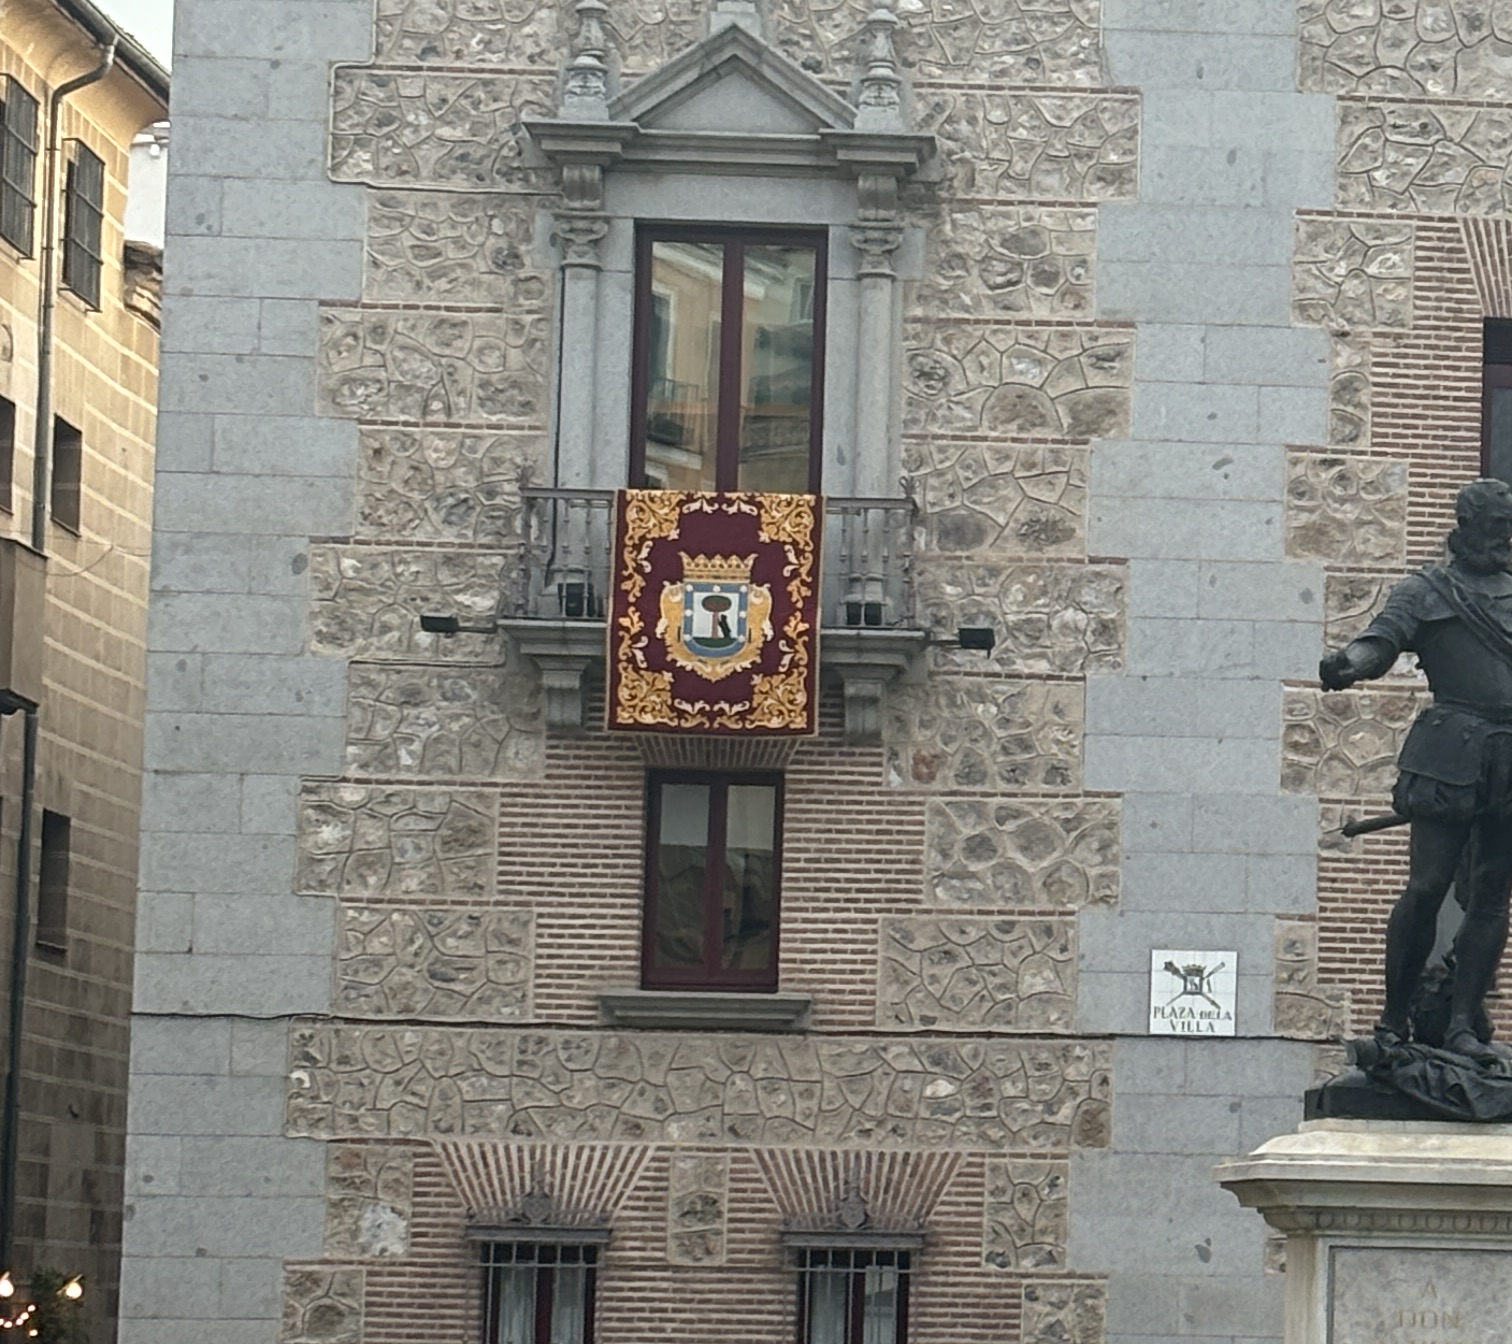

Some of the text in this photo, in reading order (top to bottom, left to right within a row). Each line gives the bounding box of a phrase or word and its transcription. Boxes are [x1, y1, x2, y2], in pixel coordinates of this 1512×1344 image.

[1153, 1006, 1195, 1019] PLAZA
[1170, 1019, 1215, 1033] VILLA
[1420, 1278, 1438, 1299] A
[1399, 1310, 1462, 1330] DON
